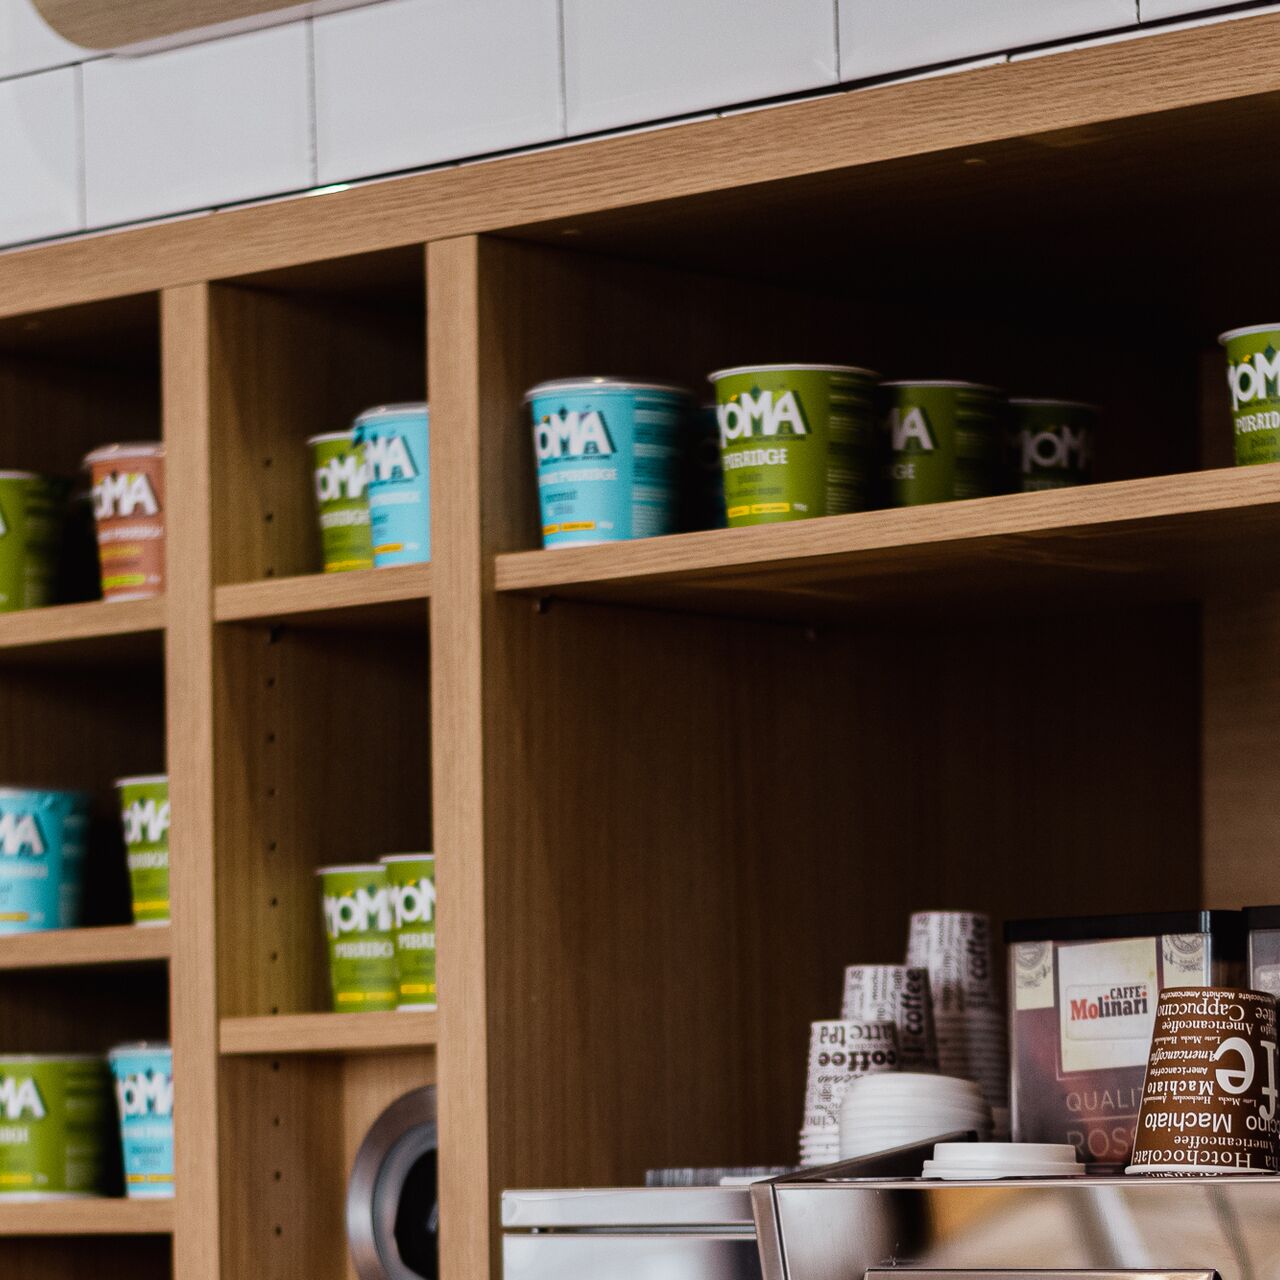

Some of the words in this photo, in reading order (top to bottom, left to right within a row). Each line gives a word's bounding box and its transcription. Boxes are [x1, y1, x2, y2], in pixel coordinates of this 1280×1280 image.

[1071, 995, 1148, 1021] Molinari
[1157, 998, 1245, 1022] Cappuccino
[1161, 1020, 1254, 1037] Americancoffee
[818, 1051, 897, 1072] coffee
[1147, 1079, 1214, 1096] Machiato
[1218, 1096, 1241, 1106] Mocha
[1144, 1110, 1232, 1134] Machiato
[1133, 1149, 1252, 1169] Hotchocolate
